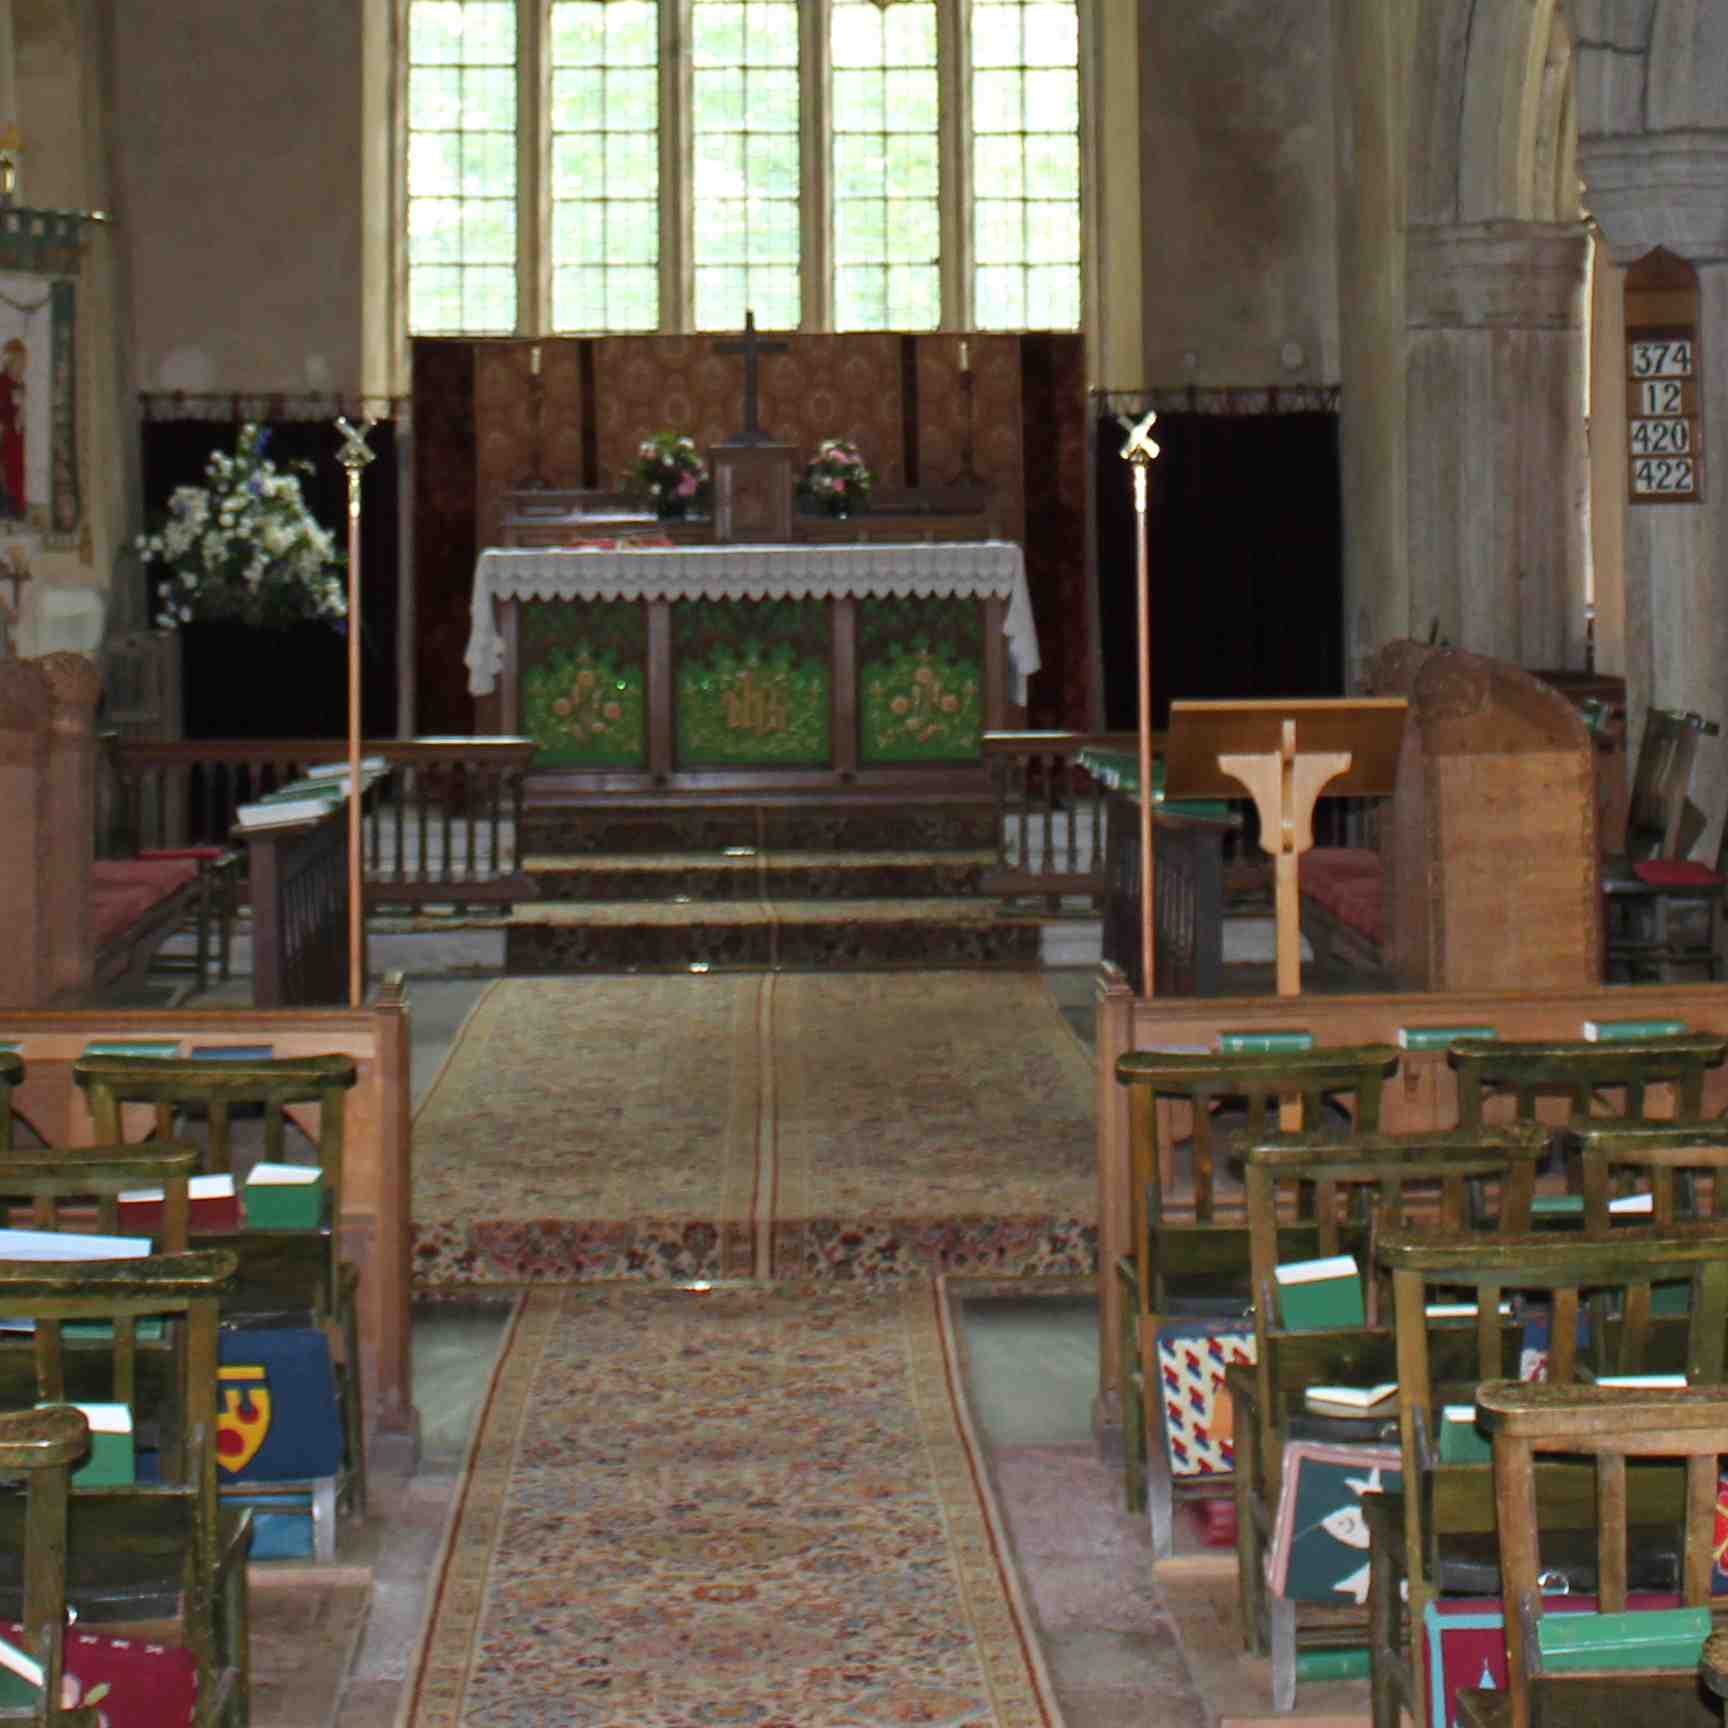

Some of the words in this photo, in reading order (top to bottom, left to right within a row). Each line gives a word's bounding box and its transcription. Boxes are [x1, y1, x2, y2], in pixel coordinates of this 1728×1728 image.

[1633, 343, 1690, 374] 374
[1648, 383, 1680, 413] 12
[1632, 421, 1688, 452] 420
[1637, 460, 1691, 491] 422
